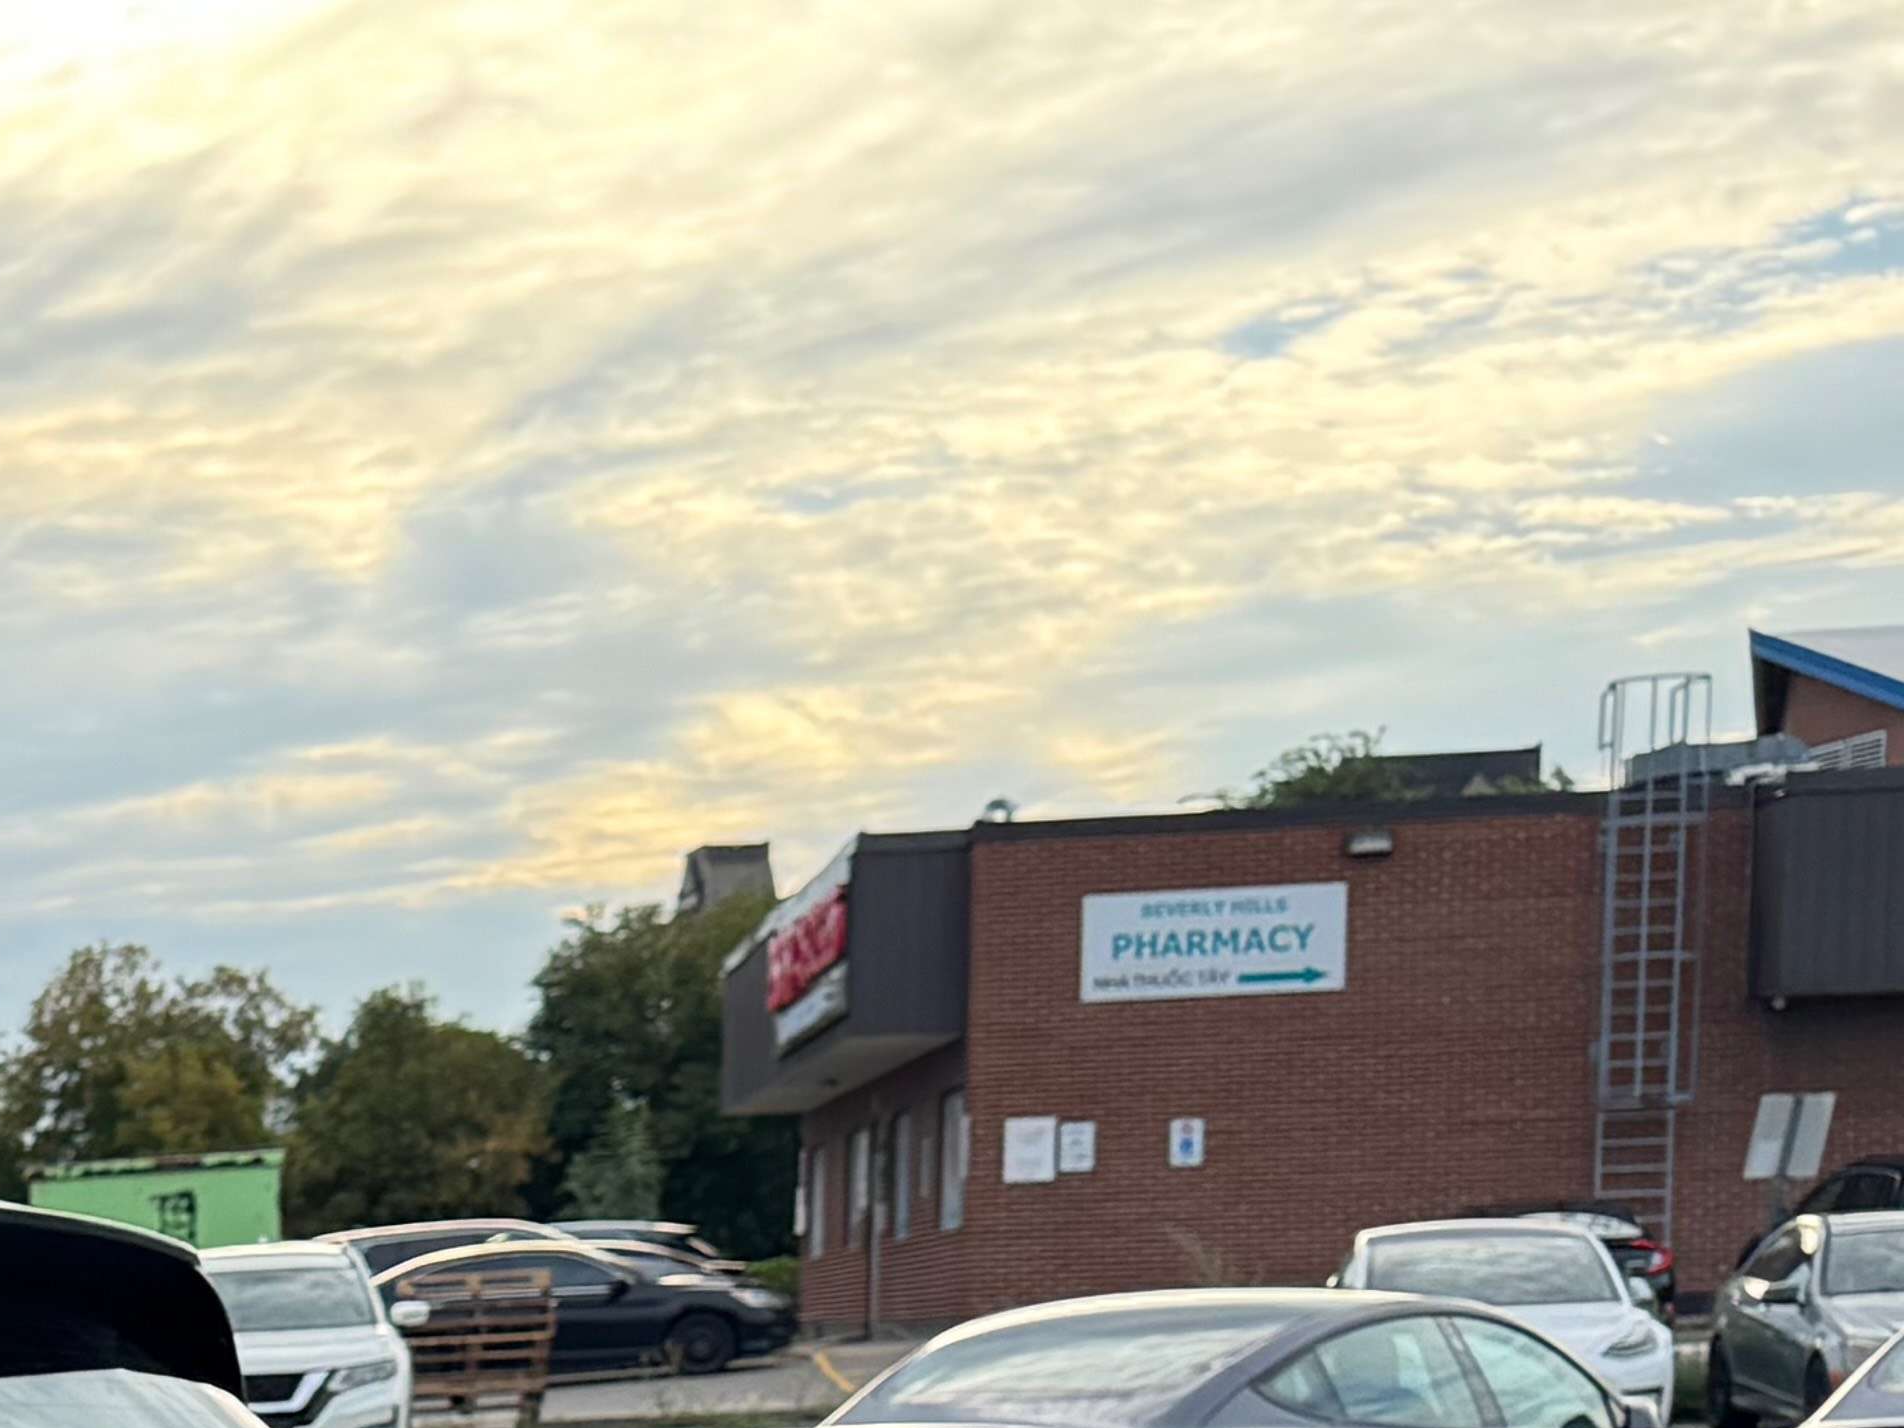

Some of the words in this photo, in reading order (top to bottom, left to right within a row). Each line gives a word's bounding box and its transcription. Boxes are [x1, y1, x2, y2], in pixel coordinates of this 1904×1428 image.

[1141, 900, 1225, 918] BEVERLY
[1230, 896, 1288, 915] HILLS
[1112, 924, 1314, 960] PHARMACY
